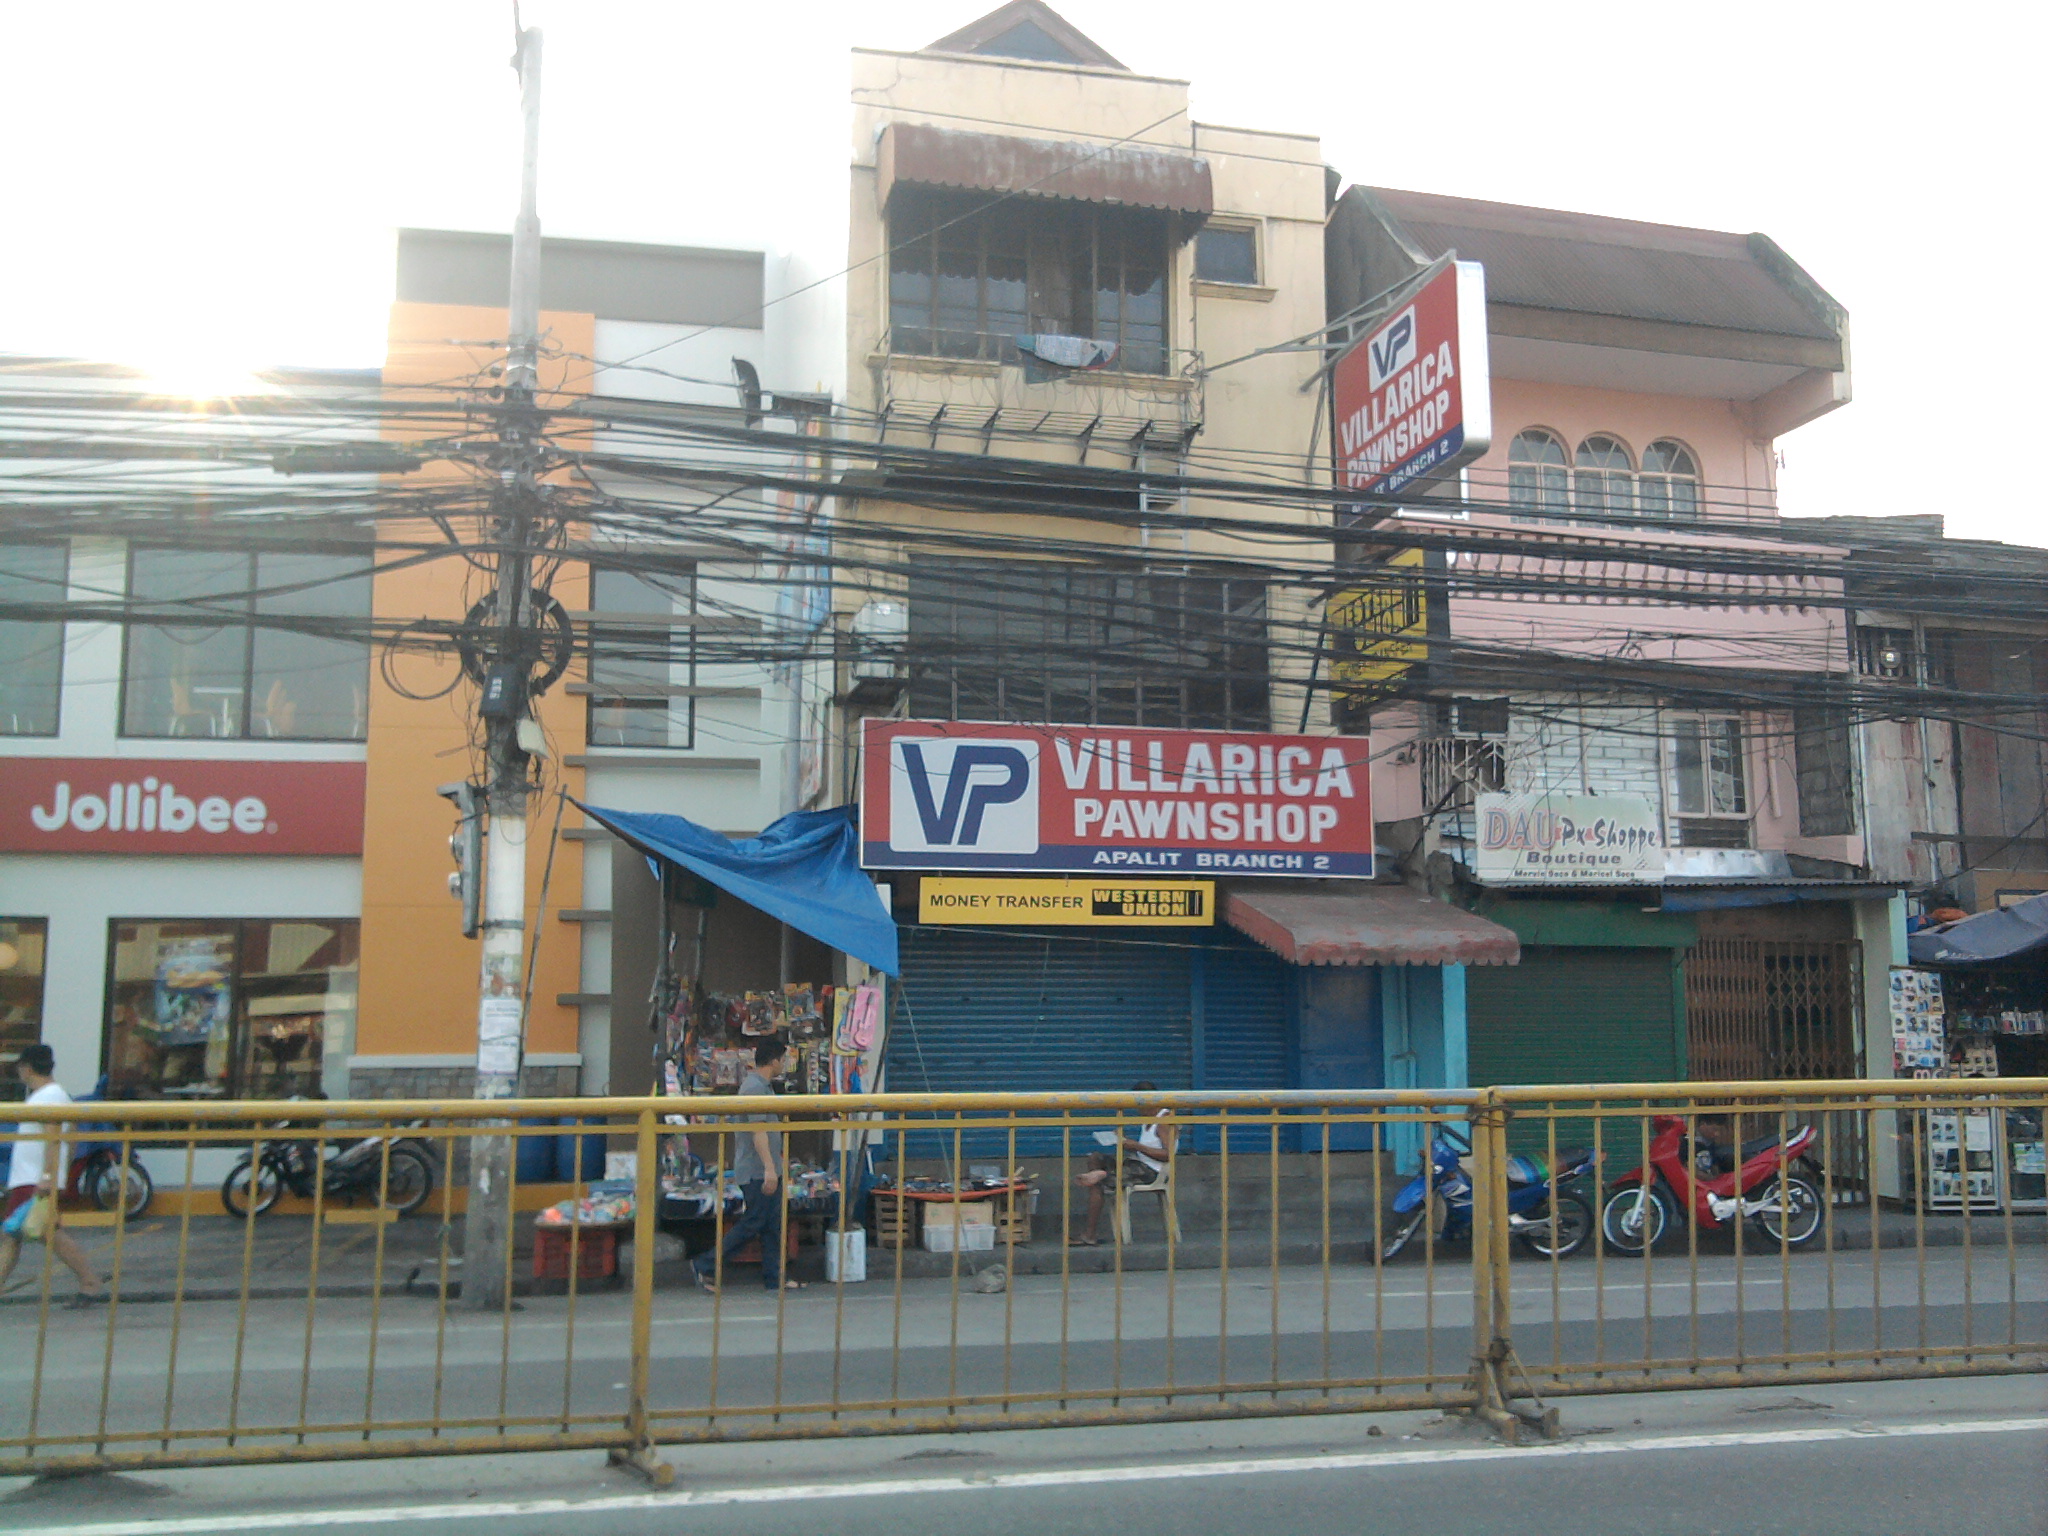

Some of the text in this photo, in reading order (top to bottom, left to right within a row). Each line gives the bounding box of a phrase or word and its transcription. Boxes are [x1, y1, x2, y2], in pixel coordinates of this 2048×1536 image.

[1371, 314, 1411, 379] VP
[1340, 341, 1454, 456] VILLARICA
[1346, 389, 1450, 490] PAWNSHOP
[1389, 438, 1449, 492] BRANCH 2
[1053, 736, 1354, 798] VILLARICA
[31, 776, 268, 835] Jollibee
[900, 742, 1031, 847] VP
[1074, 797, 1339, 844] PAWNSHOP
[1483, 808, 1657, 854] DAU Px Shoppe
[1092, 850, 1330, 870] APALIT BRANCH 2
[1526, 851, 1622, 867] Boutique
[929, 893, 1083, 909] MONEY TRANSFER
[1093, 889, 1187, 904] WESTERN
[1121, 902, 1187, 917] UNION
